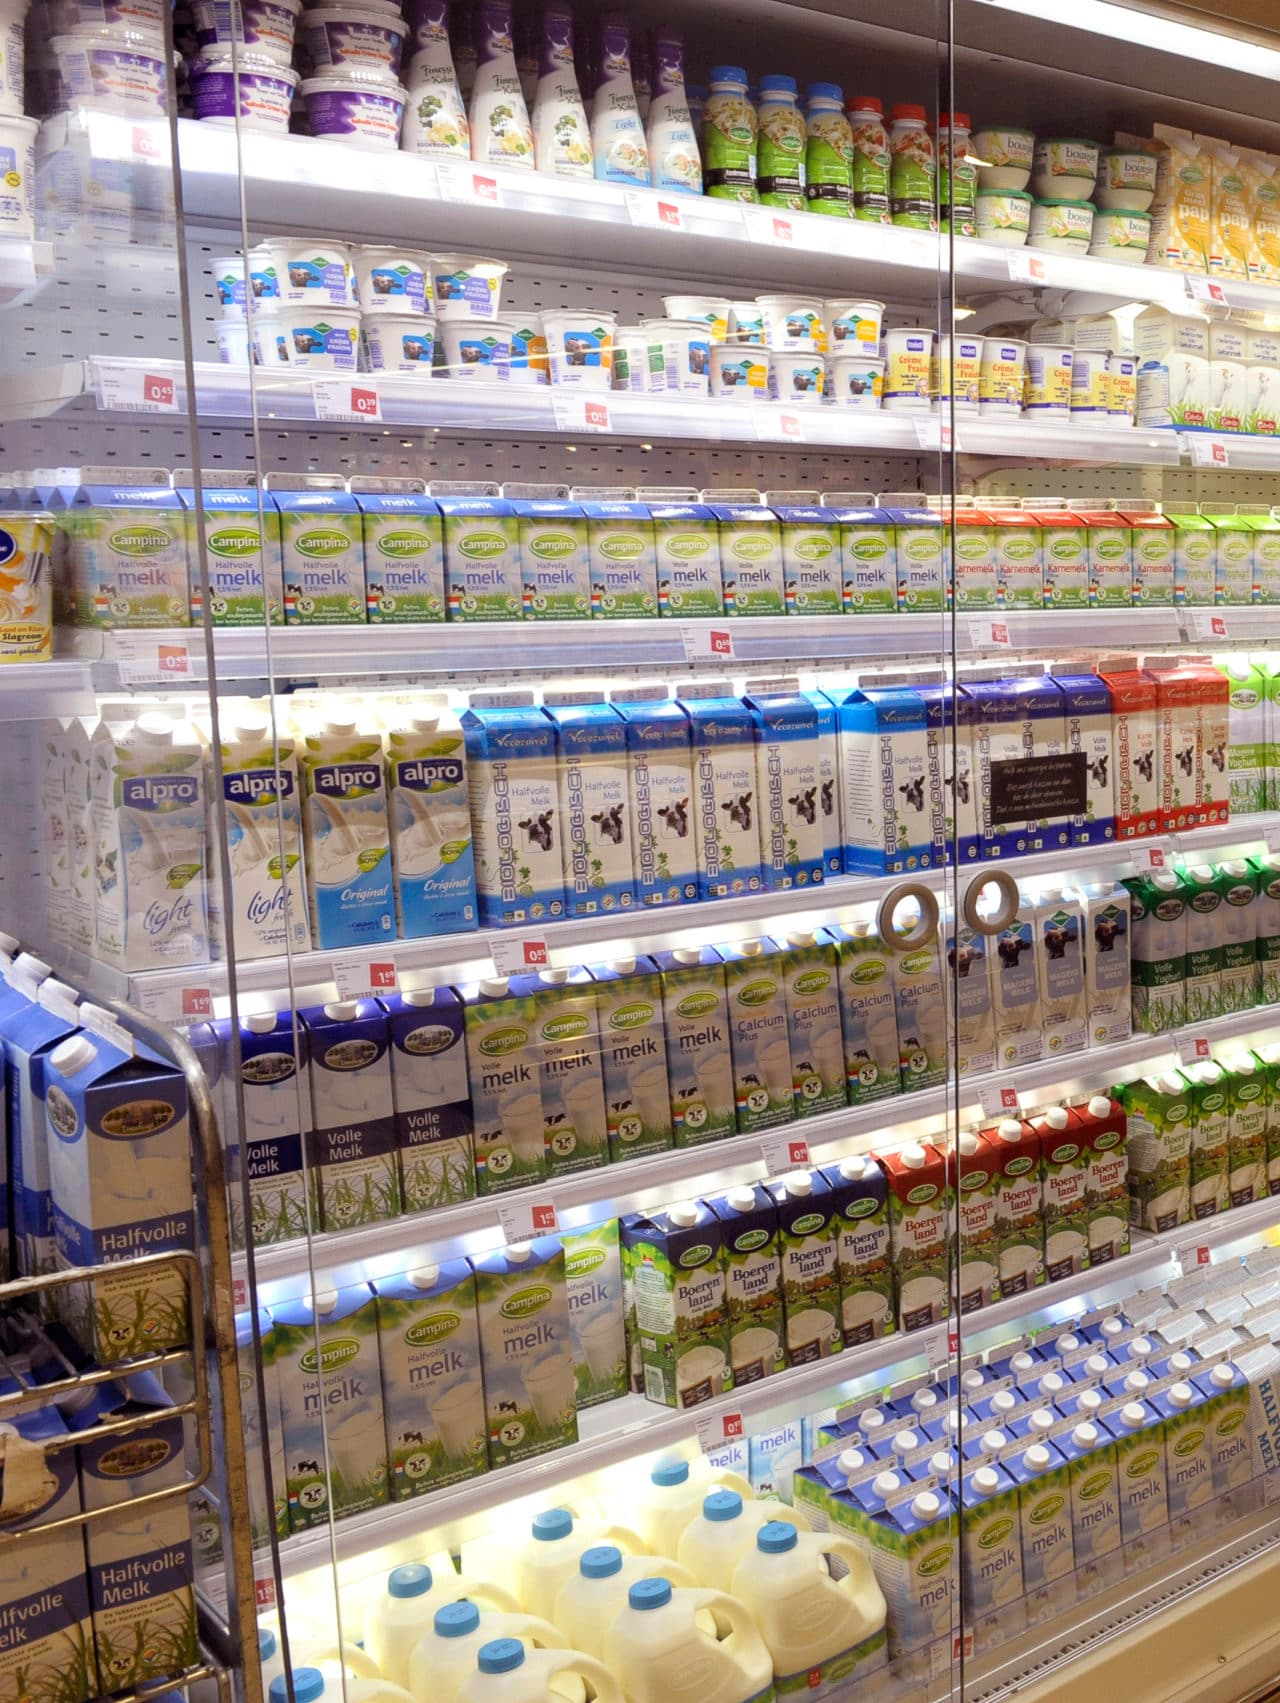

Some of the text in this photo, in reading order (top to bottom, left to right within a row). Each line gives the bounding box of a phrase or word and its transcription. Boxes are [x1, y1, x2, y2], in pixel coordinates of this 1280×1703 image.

[1178, 204, 1210, 223] pap
[1221, 212, 1250, 230] pap
[151, 386, 173, 399] 0.45
[111, 533, 170, 549] Campina
[297, 536, 349, 550] Campina
[380, 537, 430, 550] Campina
[460, 539, 507, 552] Campina
[531, 540, 575, 552] Campina
[601, 540, 644, 553] Campina
[667, 539, 708, 551] Campina
[215, 561, 253, 570] Halfvolle
[303, 561, 339, 569] Halfvolle
[384, 561, 419, 569] Halfvolle
[465, 562, 498, 570] Halfvolle
[1000, 563, 1041, 574] Karnemelk
[1047, 563, 1087, 574] Karnemelk
[1093, 563, 1131, 574] Karnemelk
[1137, 563, 1173, 573] Karnemelk
[304, 570, 348, 585] melk
[386, 571, 428, 585] melk
[466, 570, 506, 585] melk
[537, 571, 574, 584] melk
[606, 571, 641, 584] melk
[674, 569, 708, 582] melk
[739, 569, 772, 583] melk
[800, 570, 830, 583] melk
[404, 762, 459, 787] alpro
[715, 770, 750, 781] Halfvolle
[909, 764, 924, 773] Melk
[229, 776, 289, 802] alpro
[320, 768, 376, 794] alpro
[651, 775, 686, 787] Halfvolle
[733, 779, 750, 789] Melk
[130, 779, 194, 808] alpro
[512, 784, 550, 796] Halfvolle
[669, 785, 687, 794] Melk
[531, 797, 550, 806] Melk
[768, 745, 785, 871] BIOLOGISCH
[635, 752, 655, 887] BIOLOGISCH
[700, 748, 720, 879] BIOLOGISCH
[493, 762, 515, 902] BIOLOGISCH
[424, 876, 471, 893] Original
[341, 885, 389, 903] Original
[247, 886, 294, 924] light
[142, 897, 194, 934] light
[1225, 946, 1244, 957] Volle
[1154, 962, 1173, 973] Volle
[900, 981, 939, 999] Calcium
[611, 1007, 653, 1024] Campina
[793, 1003, 837, 1021] Calcium
[543, 1018, 589, 1035] Campina
[678, 1024, 695, 1032] Volle
[737, 1015, 784, 1033] Calcium
[481, 1030, 528, 1049] Campina
[679, 1026, 722, 1051] melk
[612, 1040, 658, 1061] melk
[481, 1062, 501, 1071] Volle
[483, 1065, 531, 1090] melk
[407, 1112, 441, 1128] Volle
[1236, 1110, 1264, 1124] Boeren
[328, 1129, 362, 1145] Volle
[409, 1127, 442, 1142] Melk
[329, 1144, 363, 1161] Melk
[1091, 1160, 1125, 1176] Boeren
[1098, 1171, 1119, 1184] land
[1002, 1185, 1038, 1203] Boeren
[1010, 1197, 1032, 1211] land
[905, 1214, 944, 1233] Boeren
[102, 1221, 187, 1250] Halfvolle
[844, 1228, 885, 1247] Boeren
[913, 1225, 937, 1241] land
[790, 1244, 833, 1264] Boeren
[853, 1241, 879, 1257] land
[732, 1261, 775, 1282] Boeren
[799, 1258, 825, 1274] land
[678, 1277, 720, 1300] Boeren
[742, 1275, 769, 1293] land
[503, 1289, 550, 1313] Campina
[688, 1290, 714, 1308] land
[407, 1315, 459, 1340] Campina
[503, 1319, 540, 1336] Halfvolle
[407, 1346, 447, 1364] Halfvolle
[408, 1351, 465, 1384] melk
[101, 1552, 185, 1586] Halfvolle
[103, 1580, 150, 1605] Melk
[0, 1593, 63, 1629] lfvolle
[0, 1627, 28, 1648] elk
